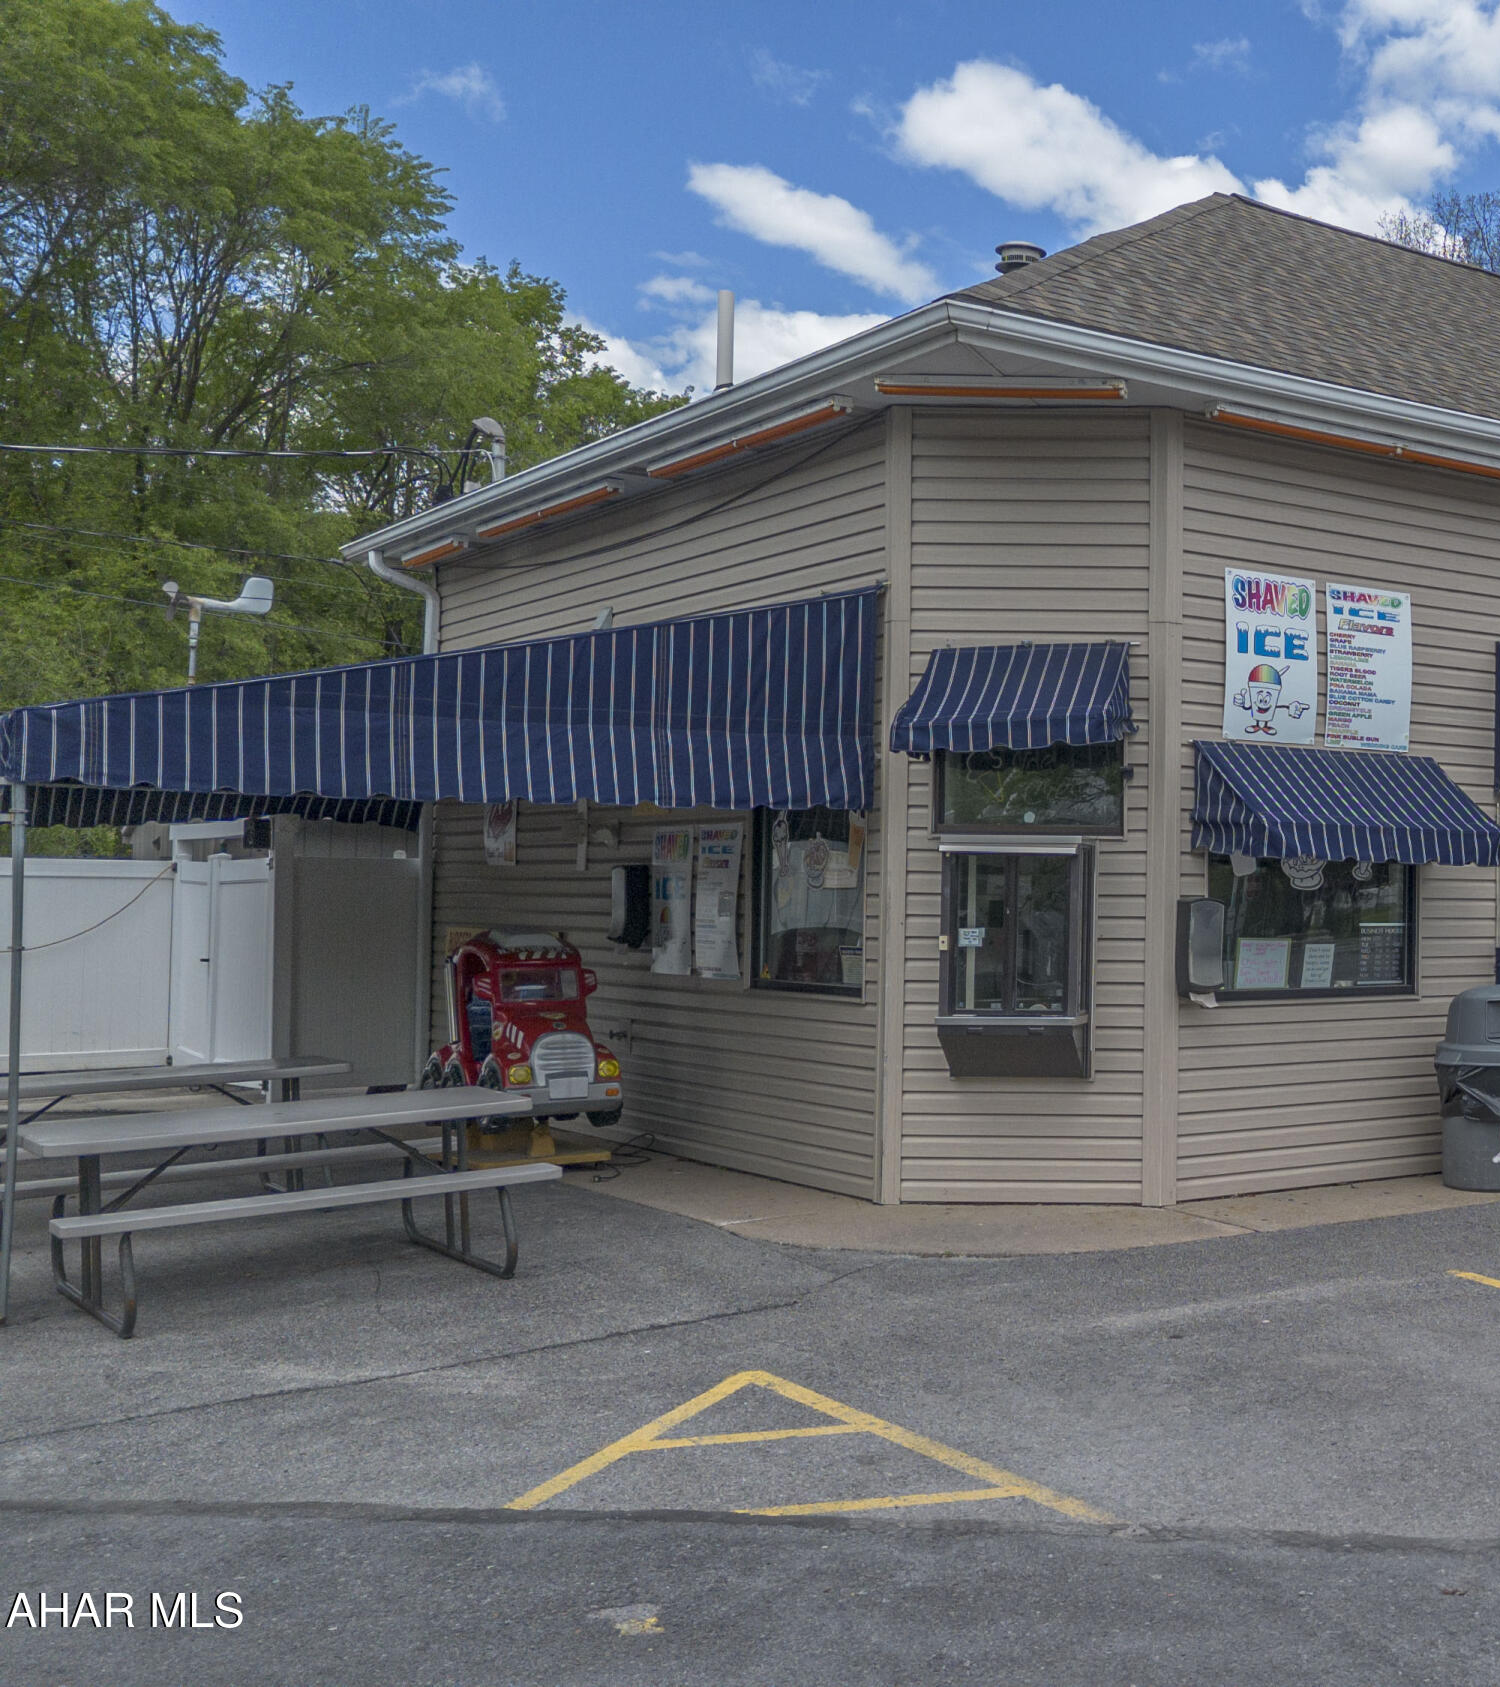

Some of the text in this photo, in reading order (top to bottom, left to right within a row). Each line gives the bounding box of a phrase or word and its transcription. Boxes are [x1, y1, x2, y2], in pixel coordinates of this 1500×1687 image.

[1232, 575, 1311, 620] SHAVED
[1329, 589, 1402, 608] SHAVED
[1333, 604, 1400, 623] ICE
[1236, 621, 1309, 661] ICE
[701, 845, 735, 855] ICE
